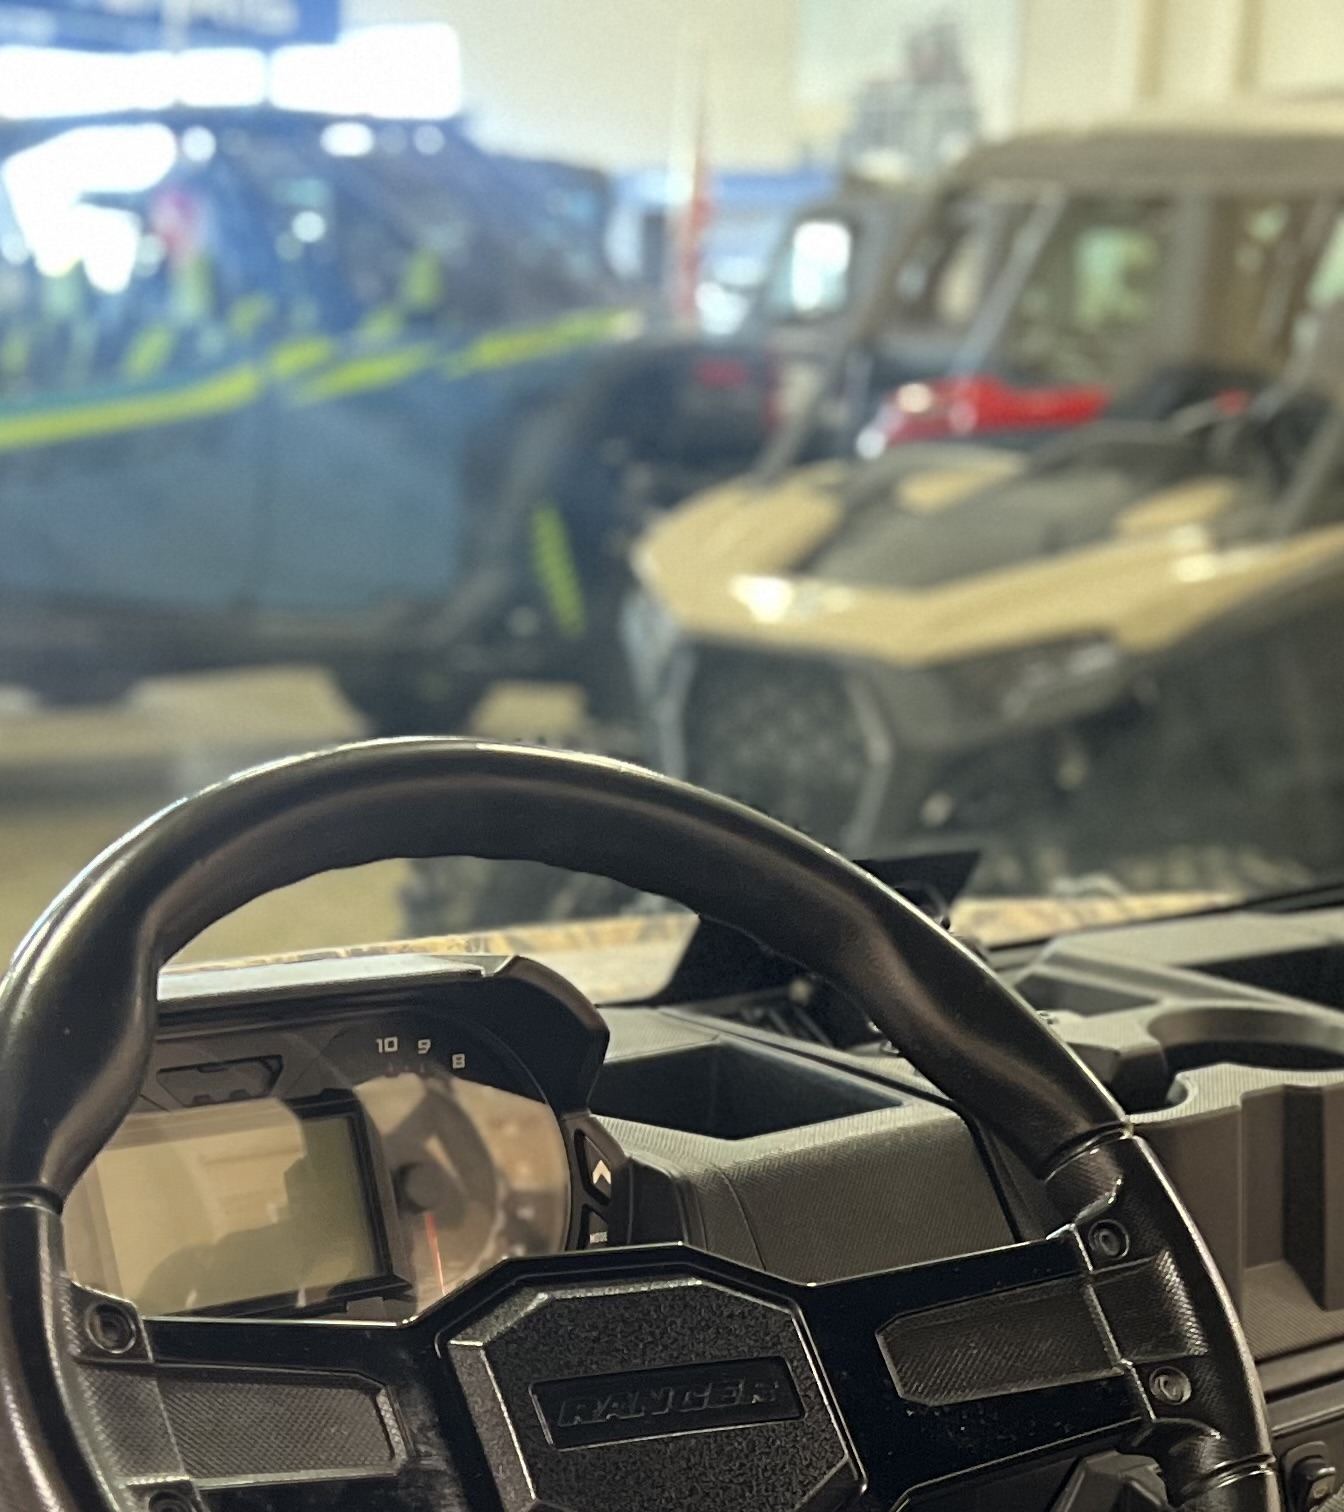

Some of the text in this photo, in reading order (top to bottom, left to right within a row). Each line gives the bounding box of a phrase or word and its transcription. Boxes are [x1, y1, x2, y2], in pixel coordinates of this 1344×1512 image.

[376, 1036, 398, 1053] 10
[417, 1038, 431, 1055] 9
[452, 1053, 465, 1069] 8
